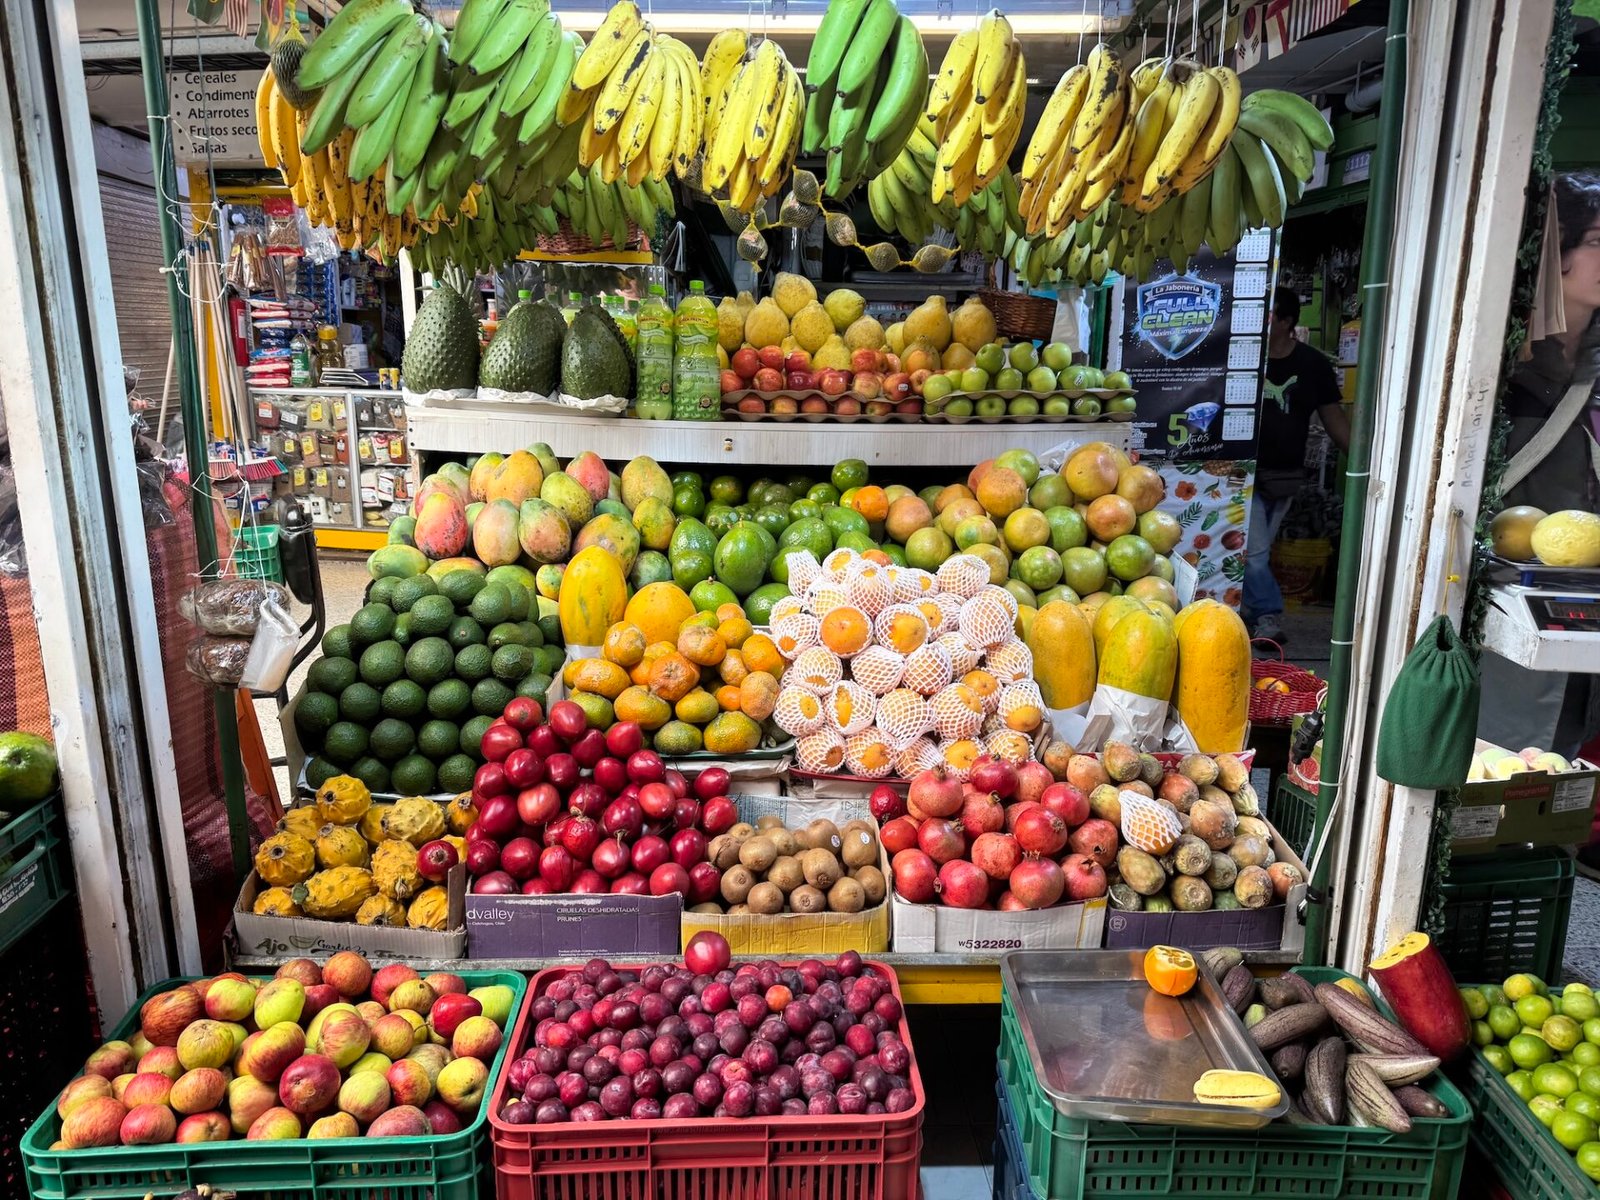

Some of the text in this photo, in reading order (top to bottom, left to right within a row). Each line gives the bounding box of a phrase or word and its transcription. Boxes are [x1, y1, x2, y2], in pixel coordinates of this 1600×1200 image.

[184, 72, 236, 83] Ceeales
[186, 90, 257, 101] Condiment
[188, 108, 249, 119] Abarrotes
[189, 125, 228, 136] Frutos
[1155, 286, 1164, 294] La
[1152, 296, 1209, 314] FULL
[1142, 308, 1214, 330] CLEAN
[1167, 413, 1189, 446] 5
[466, 907, 515, 922] dvalley
[254, 937, 288, 955] Ajo
